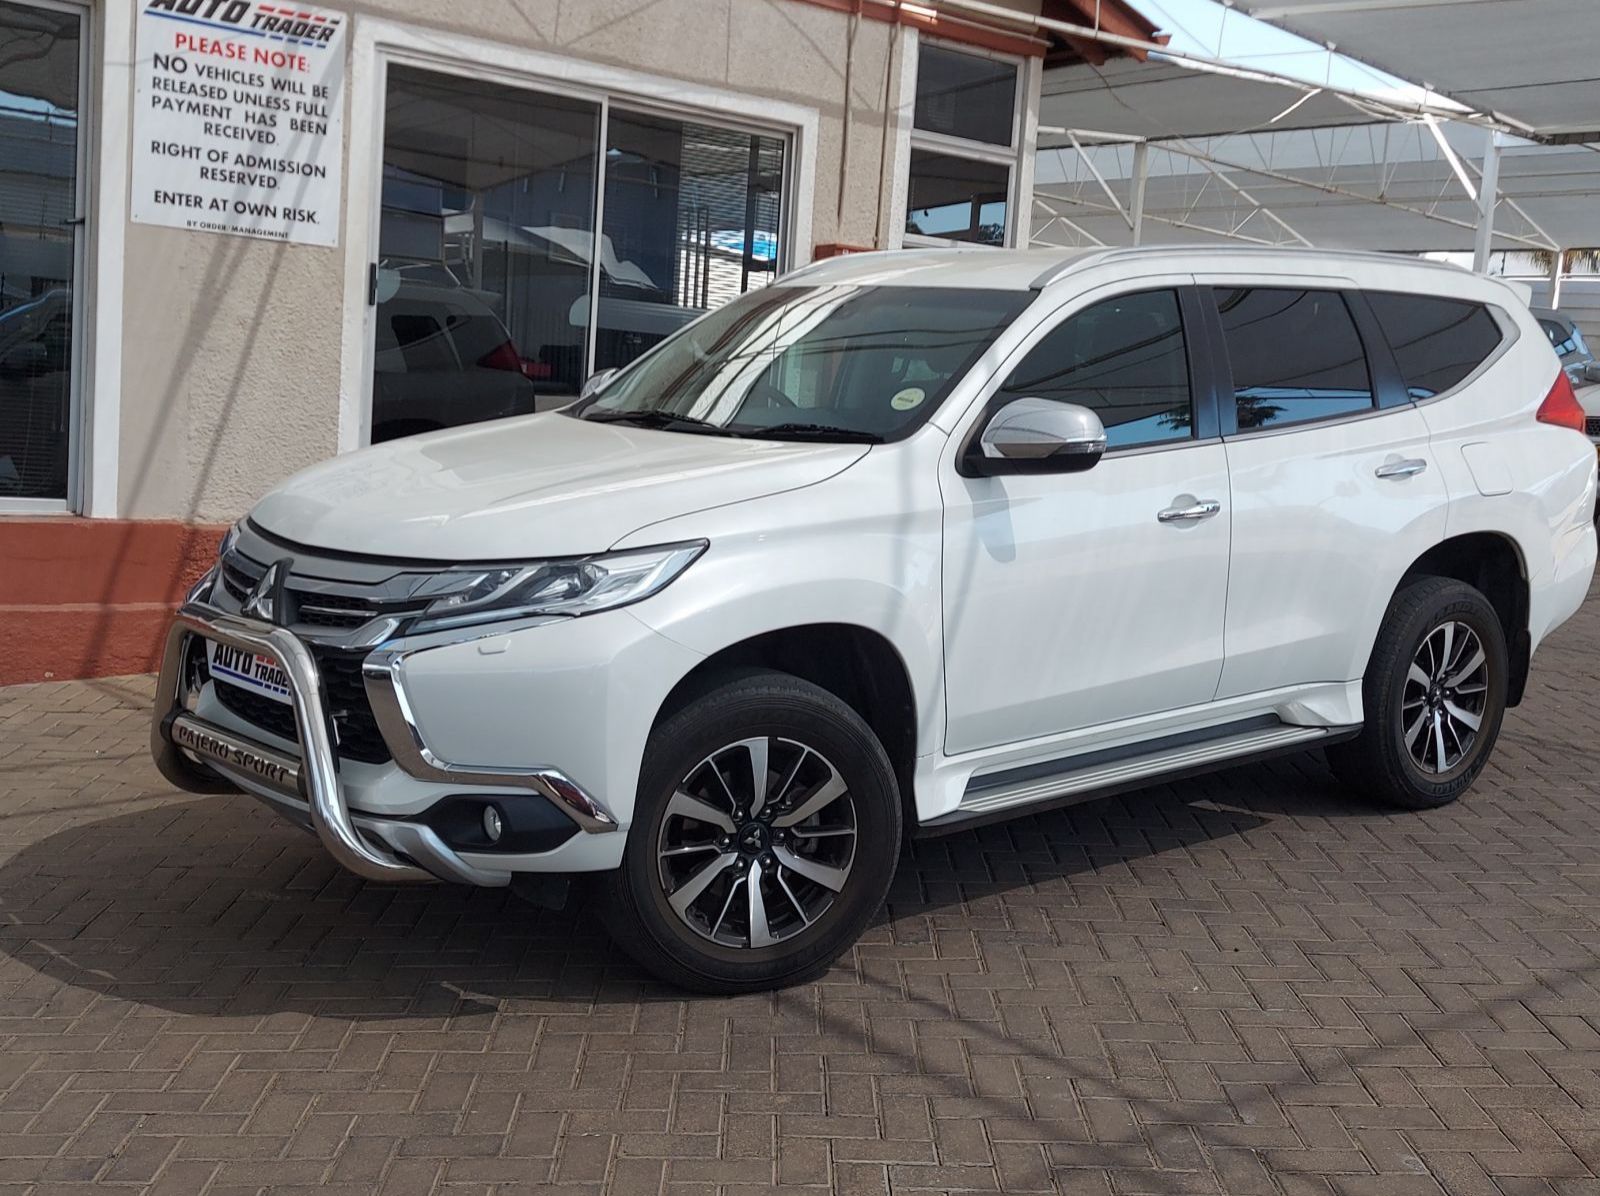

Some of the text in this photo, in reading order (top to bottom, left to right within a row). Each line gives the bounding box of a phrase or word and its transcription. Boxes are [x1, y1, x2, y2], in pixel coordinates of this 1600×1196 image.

[250, 13, 335, 42] TRADER
[175, 32, 311, 73] PLEASE NOTE:
[153, 53, 329, 99] NO VEHICLES WILL BE
[152, 76, 328, 119] RELEASED UNLESS FULL
[152, 95, 327, 136] PAYMENT HAS BEEN
[204, 122, 279, 146] RECEIVED.
[151, 140, 326, 178] RIGHT OF ADMISSION
[200, 166, 280, 190] RESERVED.
[154, 190, 320, 225] ENTER AT OWN RISK.
[186, 219, 199, 228] BY
[231, 225, 289, 239] MANAGEMENT
[213, 643, 288, 688] AUTO TRADE
[179, 726, 289, 783] PAJERO SPORT
